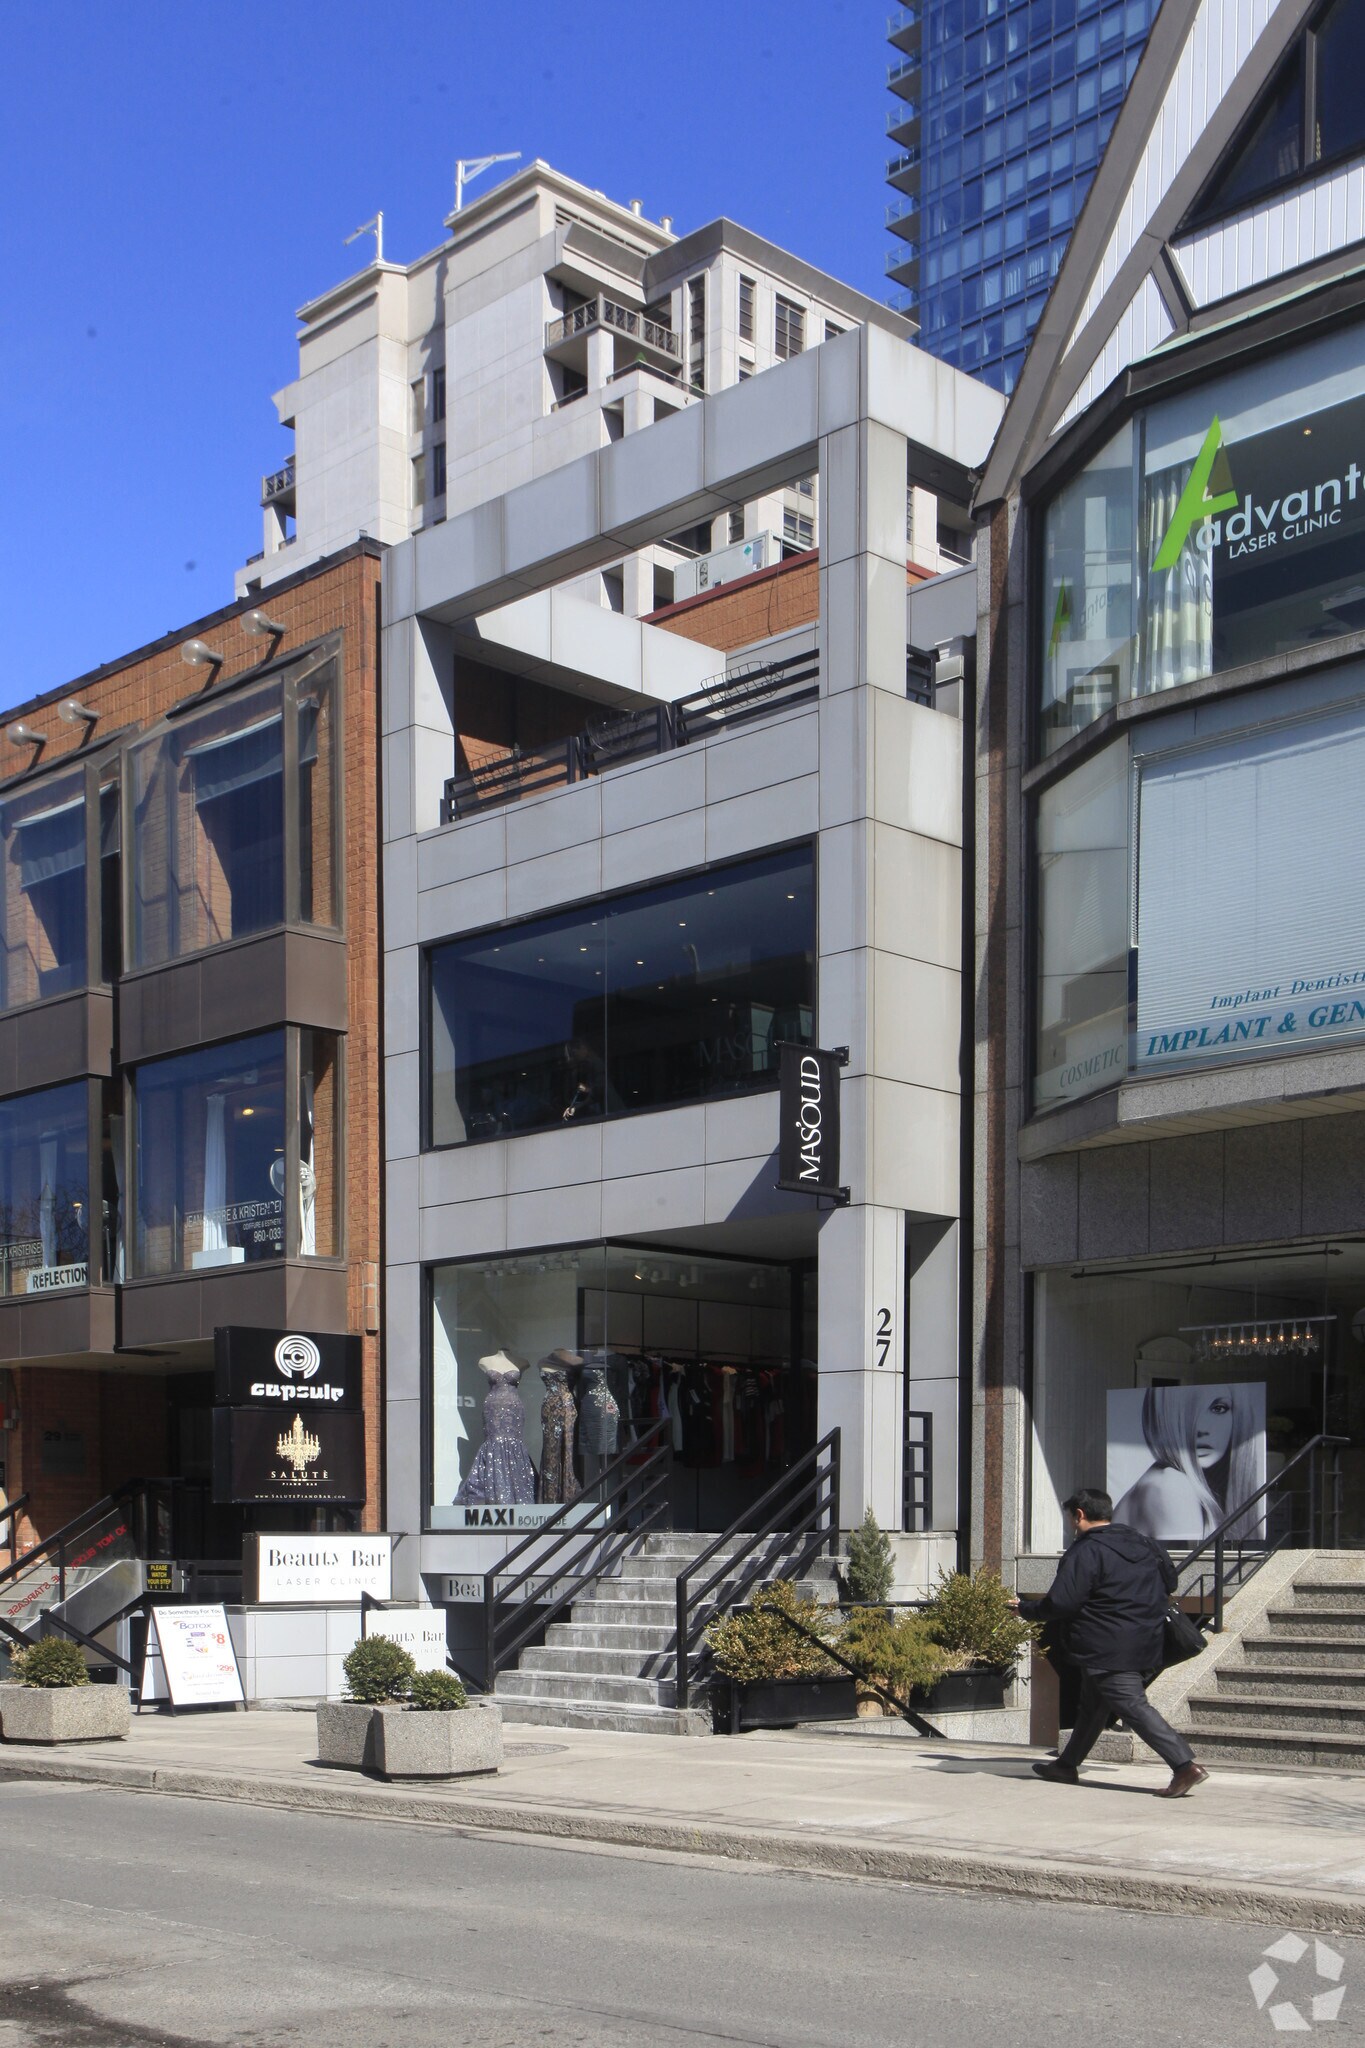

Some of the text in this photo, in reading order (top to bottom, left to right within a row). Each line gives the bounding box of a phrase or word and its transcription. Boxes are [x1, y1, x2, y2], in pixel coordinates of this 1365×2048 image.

[1196, 463, 1365, 551] advant
[1229, 509, 1342, 559] LASER CLINIC
[1210, 986, 1281, 1009] Implant
[1145, 1016, 1272, 1056] IMPLANT
[1278, 1012, 1297, 1034] &
[1060, 1044, 1124, 1089] COSMETIC
[232, 1207, 238, 1221] &
[253, 1227, 284, 1243] 960-033
[32, 1266, 88, 1289] REFLECTION
[251, 1383, 344, 1401] capsule
[464, 1508, 515, 1526] MAXI
[268, 1548, 386, 1567] Beauty Bar
[276, 1577, 377, 1586] LASER CLINIC
[168, 1608, 200, 1616] Something
[423, 1630, 444, 1642] Bar
